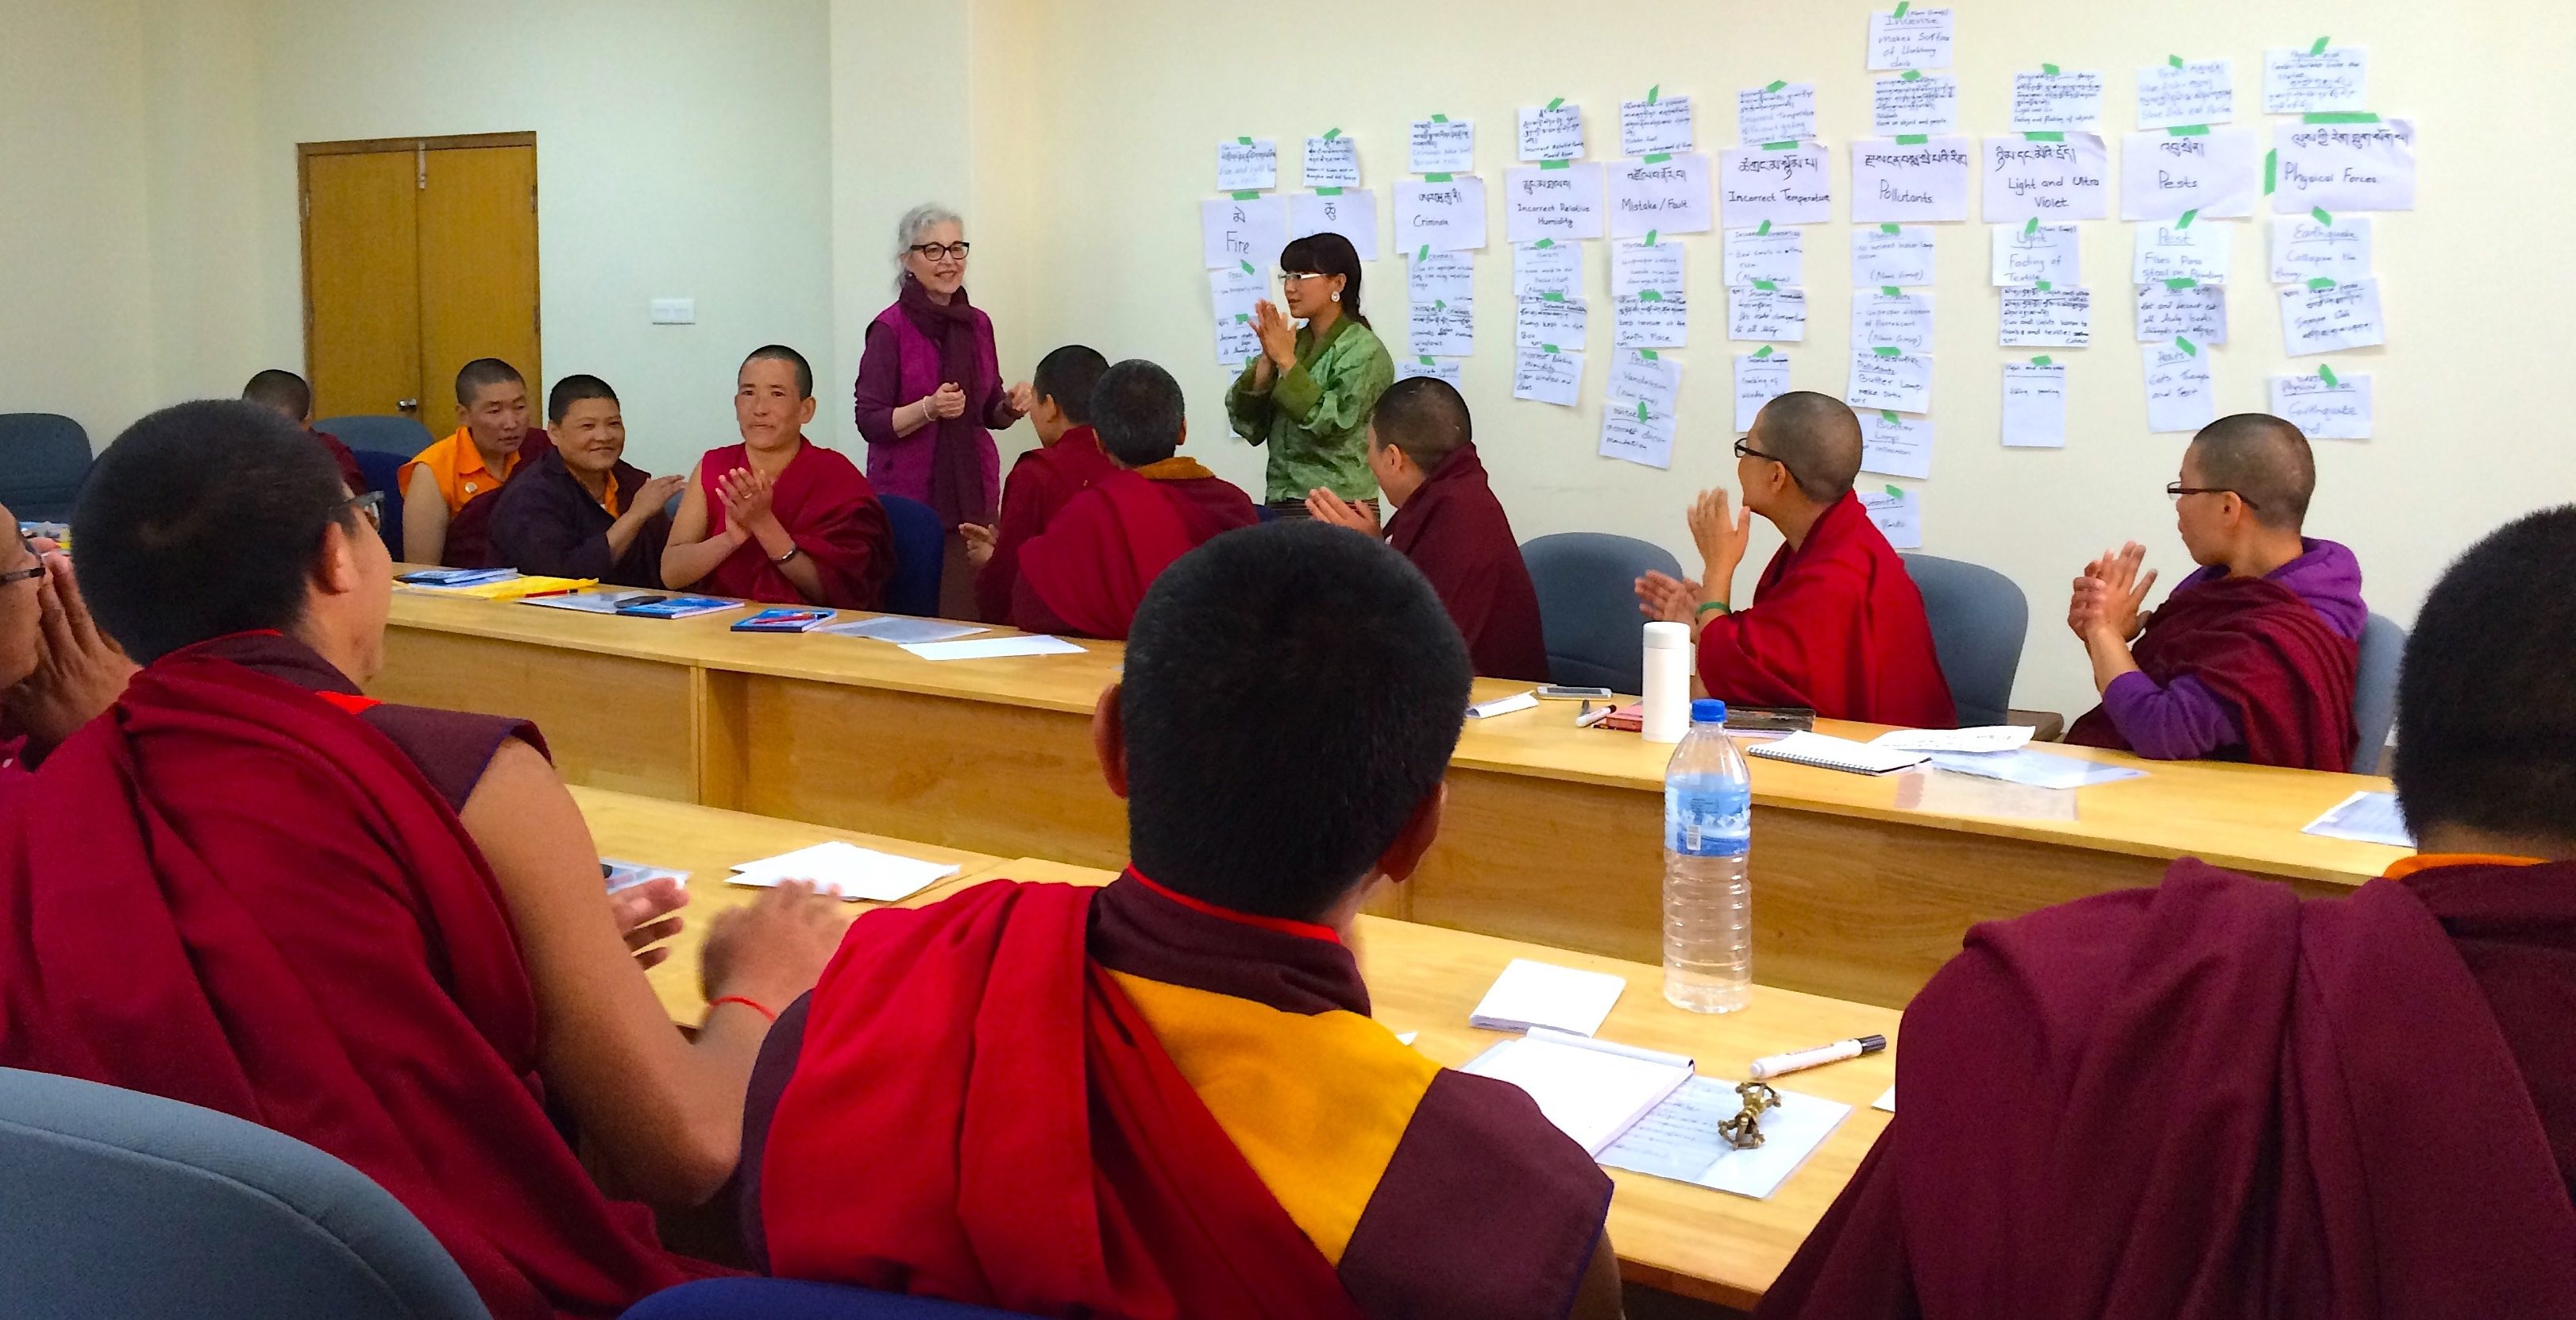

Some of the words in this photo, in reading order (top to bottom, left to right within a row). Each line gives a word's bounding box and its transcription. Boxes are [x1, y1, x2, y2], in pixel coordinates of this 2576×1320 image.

[1884, 15, 1938, 25] Incense
[2158, 169, 2198, 190] Pests
[2284, 161, 2334, 191] Physical
[2343, 167, 2377, 183] Forces
[2007, 177, 2037, 196] Light
[2042, 176, 2064, 187] and
[2072, 176, 2100, 187] Ultra
[1621, 198, 1657, 211] Mistake
[1728, 191, 1776, 203] Incorrect
[1780, 188, 1830, 206] Temperature
[2034, 196, 2070, 208] Violet
[1517, 203, 1556, 212] Incorrect
[1560, 203, 1591, 213] Relative
[1537, 217, 1574, 229] Humidity
[1226, 230, 1250, 255] Fire
[2158, 227, 2192, 246] Pest
[2293, 223, 2357, 245] Earthquake
[2009, 253, 2046, 273] Fading
[2051, 255, 2061, 265] of
[2157, 301, 2173, 310] and
[1859, 373, 1894, 386] Butter
[1900, 380, 1923, 392] Lamp
